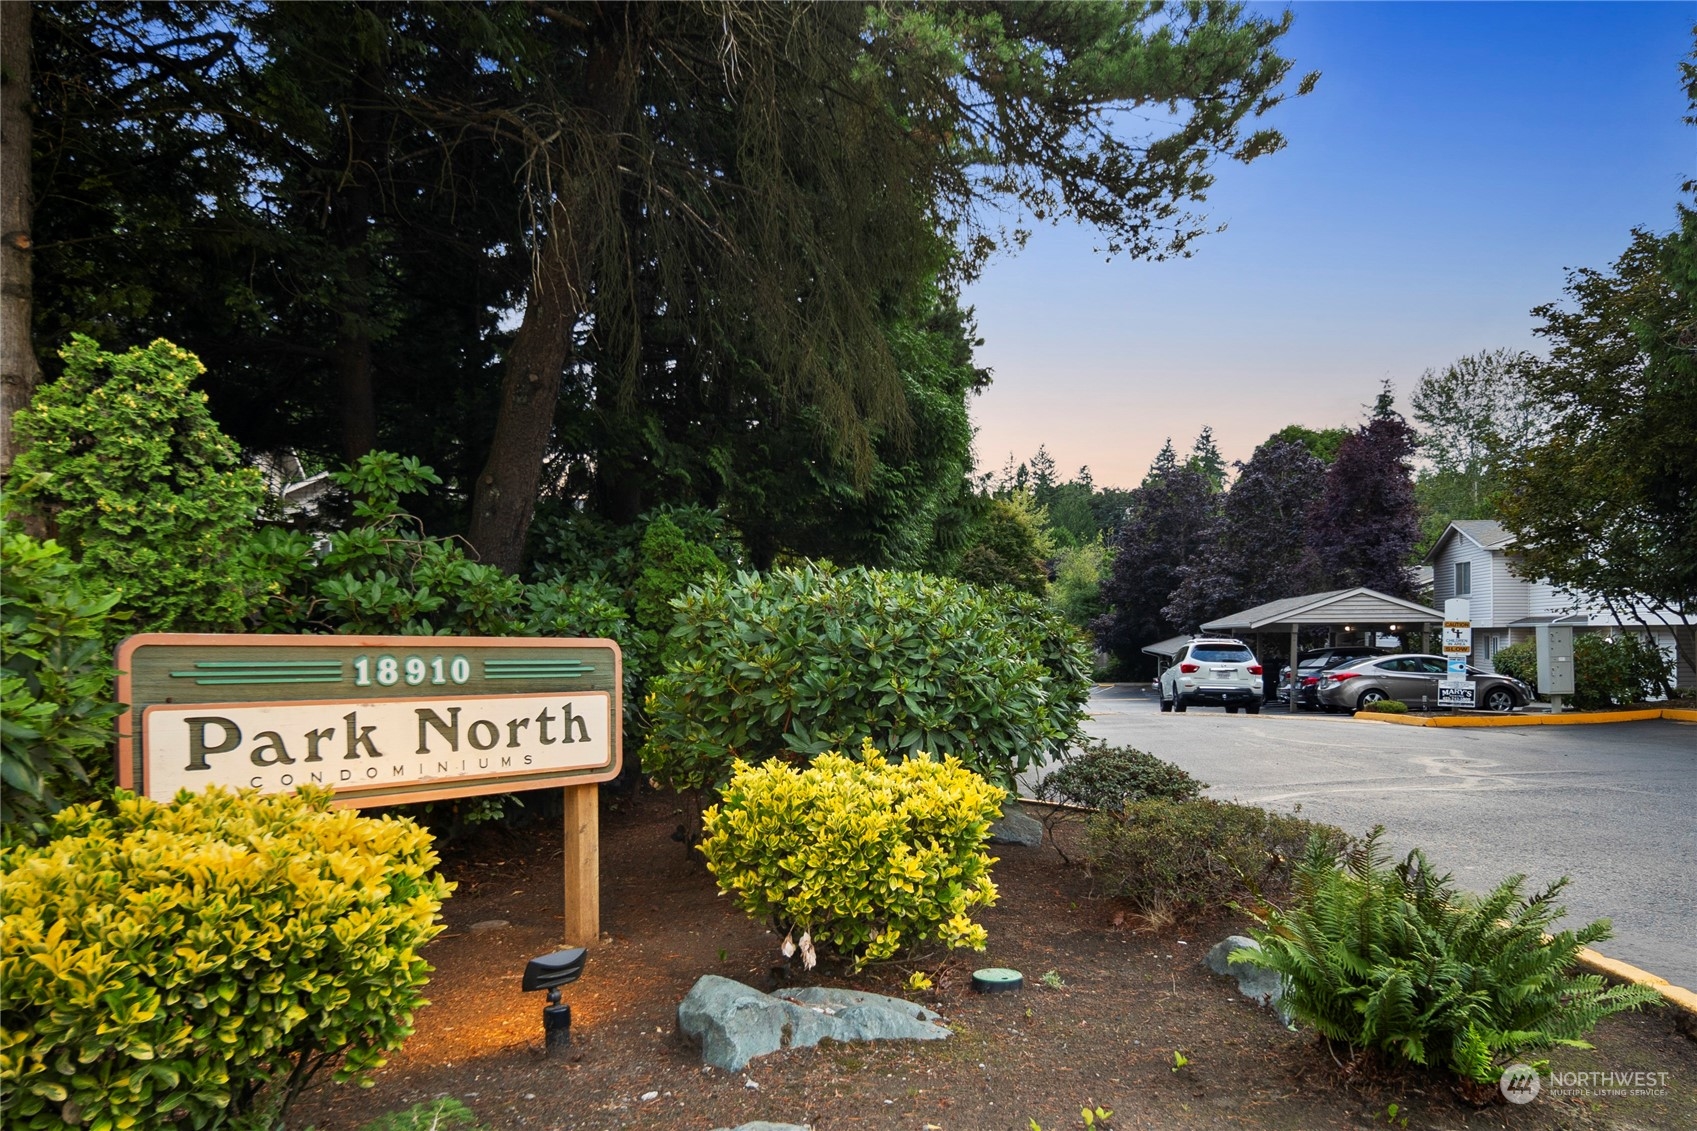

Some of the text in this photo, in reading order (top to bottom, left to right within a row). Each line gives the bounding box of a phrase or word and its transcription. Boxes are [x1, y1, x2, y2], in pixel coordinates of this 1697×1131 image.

[354, 655, 471, 686] 18910
[1441, 689, 1473, 697] MARY'S
[183, 702, 592, 772] Park North
[249, 754, 534, 788] CONDOMINIUMS
